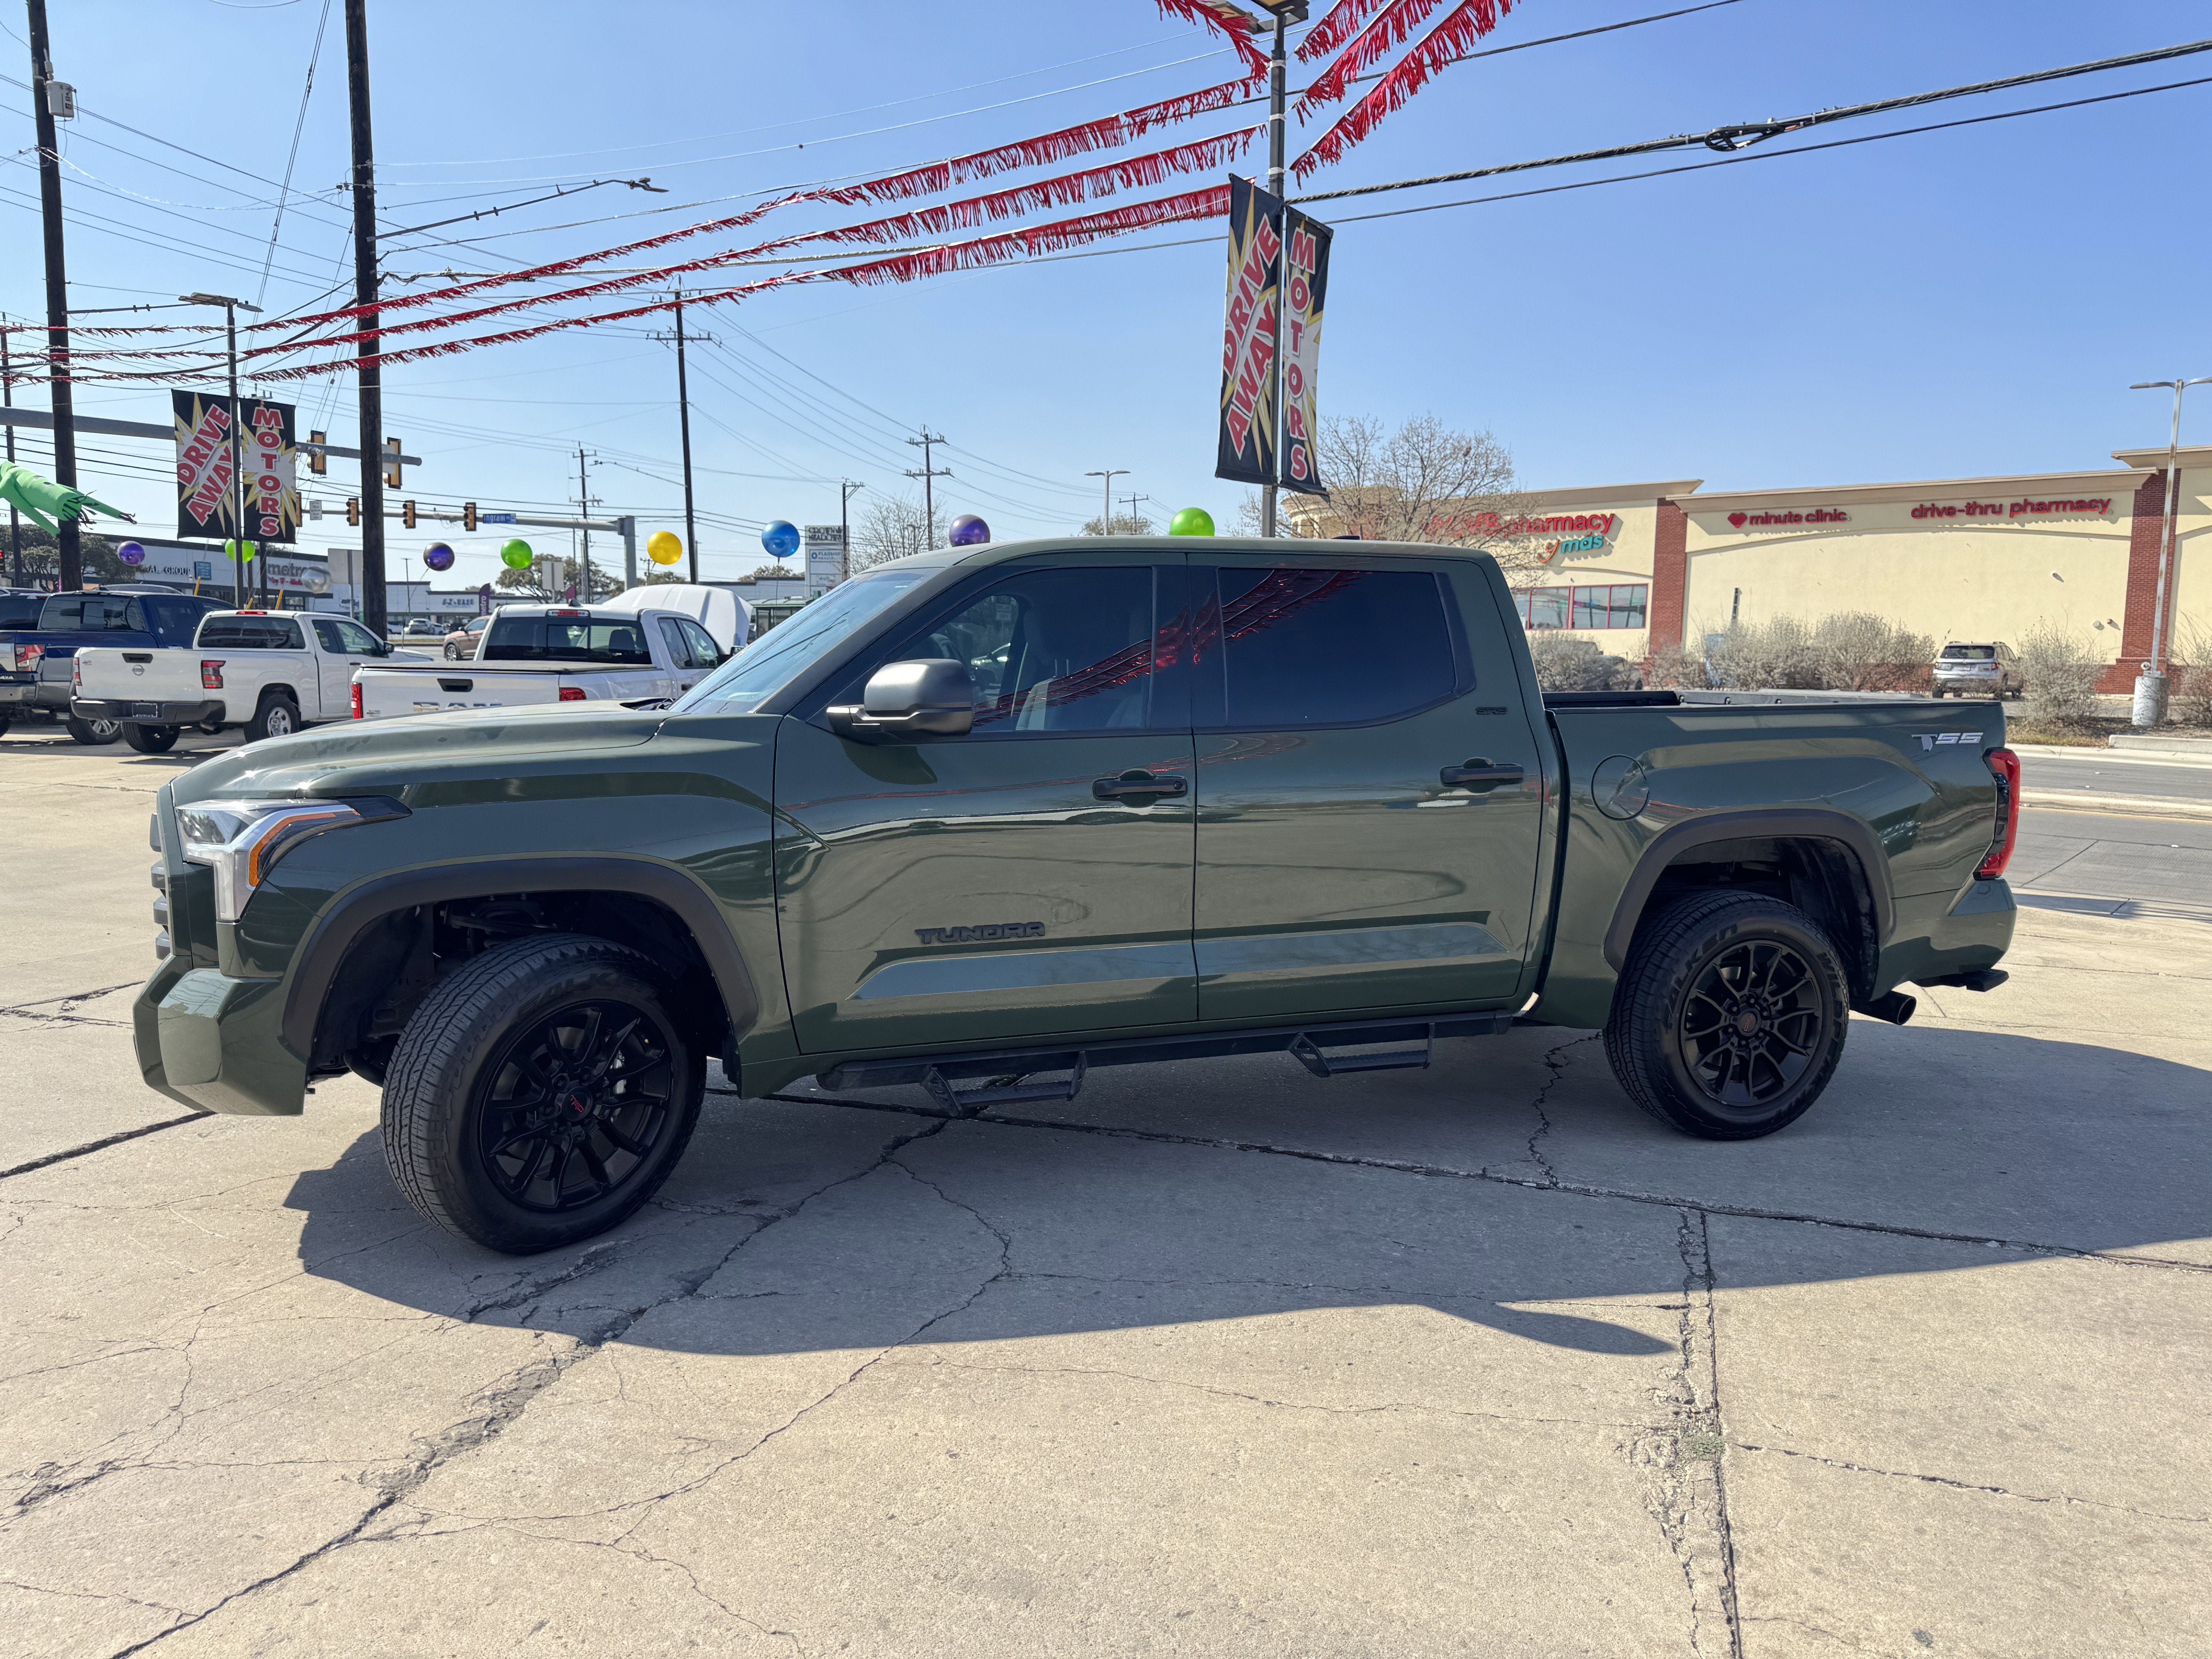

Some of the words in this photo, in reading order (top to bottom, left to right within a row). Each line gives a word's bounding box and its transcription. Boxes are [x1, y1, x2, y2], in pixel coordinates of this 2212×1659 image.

[1223, 212, 1280, 381] DRIVE
[1226, 294, 1276, 461] AWAY
[1288, 225, 1317, 481] MOTORS
[177, 403, 232, 486] DRIVE
[252, 406, 284, 537] MOTORS
[186, 443, 232, 526] AWAY
[1911, 501, 2003, 519] drive-thru
[2009, 498, 2111, 518] pharmacy
[1503, 513, 1614, 538] pharmacy
[1561, 532, 1604, 554] más
[1749, 511, 1803, 525] minute
[1805, 508, 1847, 524] clinic
[164, 566, 190, 575] GROUP
[914, 921, 1046, 944] TUNDRA
